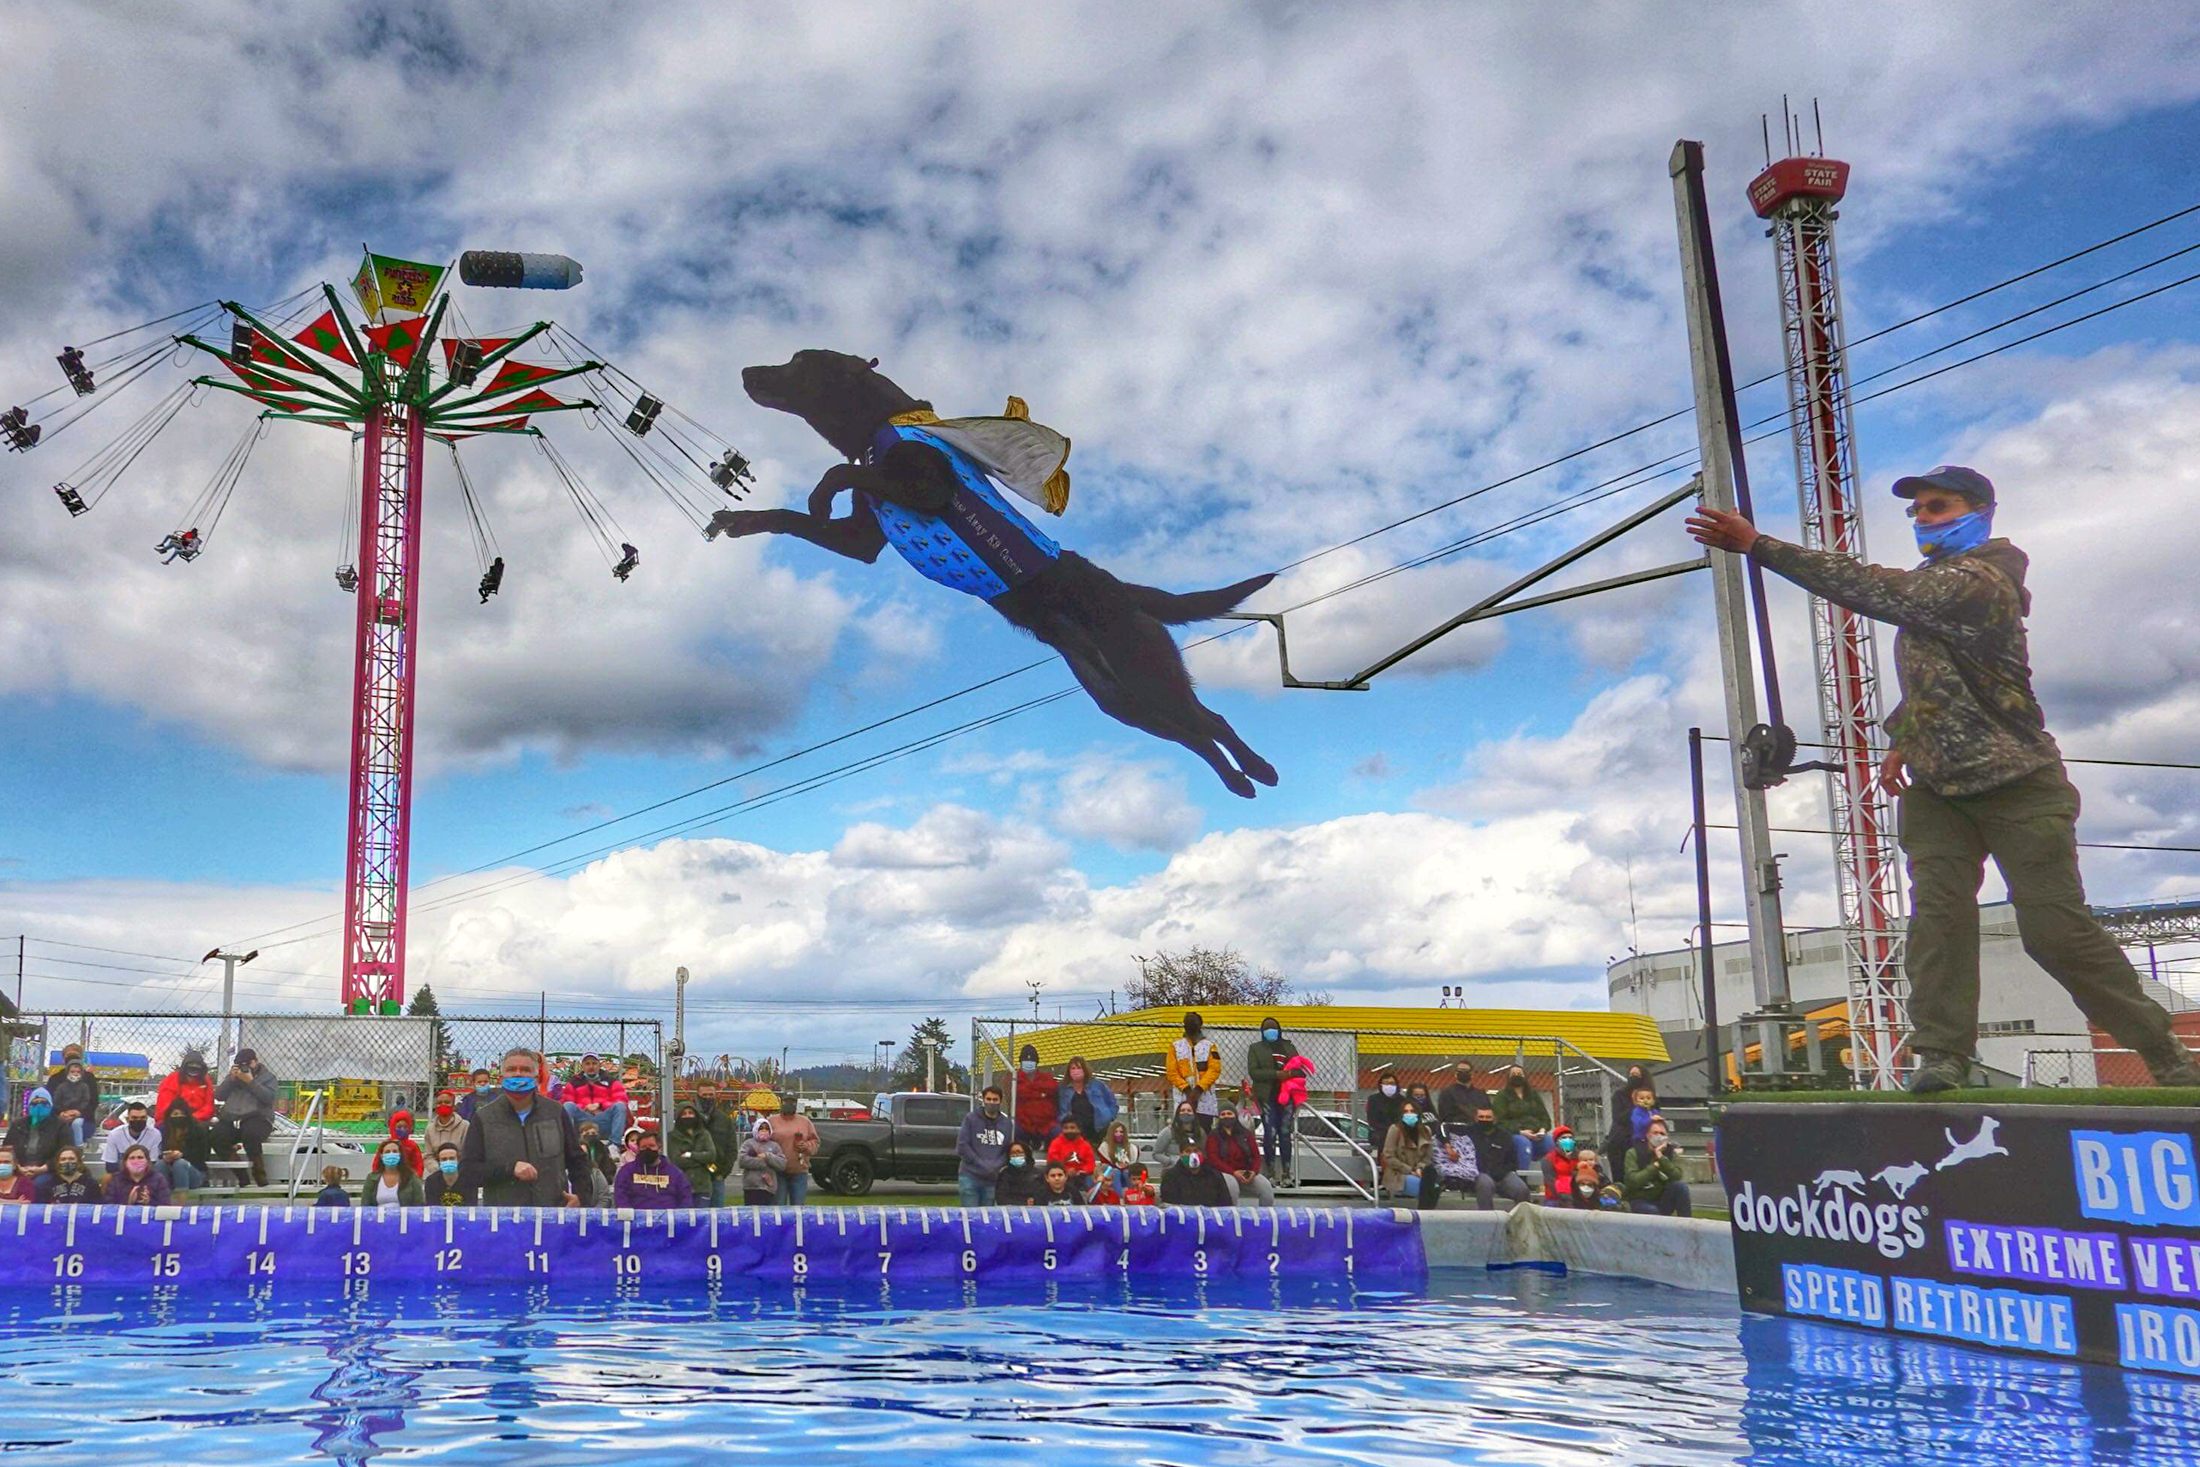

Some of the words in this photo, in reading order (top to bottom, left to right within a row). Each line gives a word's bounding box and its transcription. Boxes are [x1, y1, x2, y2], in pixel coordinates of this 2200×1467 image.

[1804, 168, 1838, 179] STATE
[1808, 177, 1832, 187] FAIR
[965, 513, 988, 536] Away
[987, 534, 1001, 548] K9
[1000, 548, 1023, 576] Cancer
[2077, 1139, 2193, 1216] BIG
[53, 1254, 84, 1278] 16
[151, 1253, 181, 1277] 15
[246, 1251, 276, 1275] 14
[341, 1252, 371, 1275] 13
[434, 1249, 463, 1271] 12
[525, 1250, 549, 1273] 11
[612, 1255, 641, 1275] 10
[707, 1254, 722, 1275] 9
[793, 1253, 808, 1275] 8
[877, 1252, 892, 1274] 7
[962, 1250, 976, 1273] 6
[1043, 1248, 1056, 1271] 5
[1116, 1249, 1130, 1270] 4
[1194, 1250, 1208, 1272] 3
[1267, 1252, 1280, 1273] 2
[1344, 1254, 1354, 1272] 1
[1950, 1226, 2121, 1285] EXTREME
[1786, 1269, 1882, 1321] SPEED
[1893, 1281, 2071, 1350] RETRIEVE
